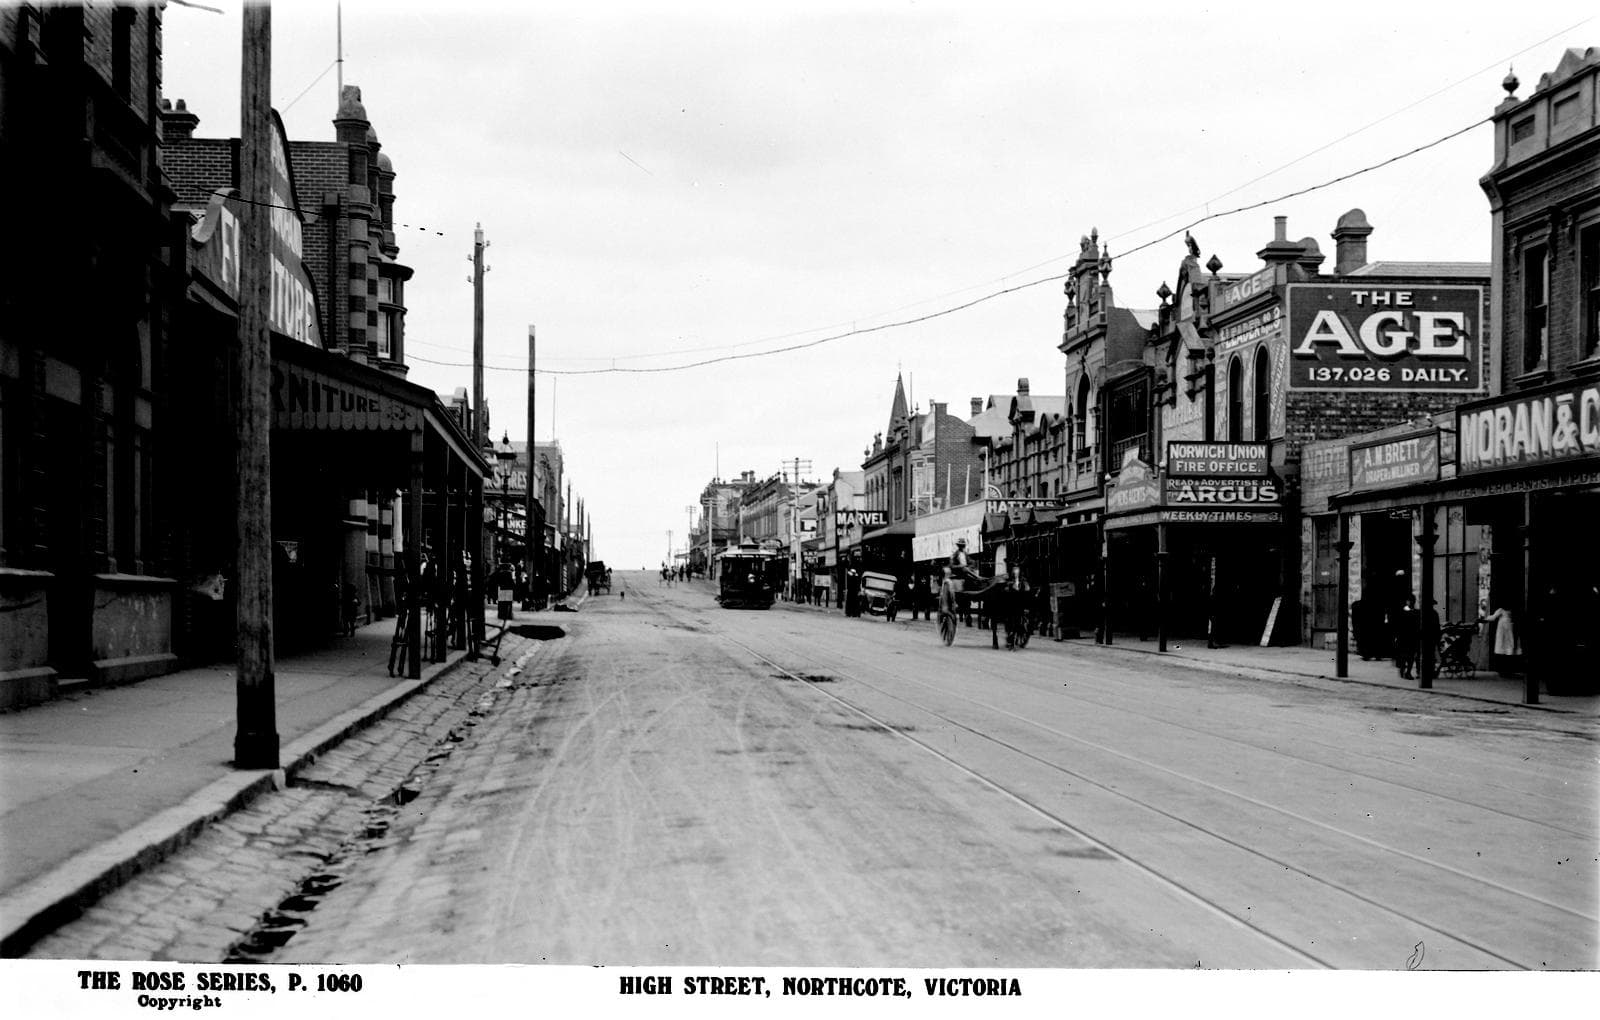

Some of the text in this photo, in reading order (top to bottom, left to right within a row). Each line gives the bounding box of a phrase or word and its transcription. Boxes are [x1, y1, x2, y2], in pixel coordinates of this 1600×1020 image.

[1351, 290, 1413, 306] THE
[1293, 309, 1466, 357] AGE
[1308, 367, 1469, 383] 137,026 DAILY.
[1460, 397, 1550, 465] MORAN
[1552, 394, 1579, 449] &
[1170, 443, 1266, 460] NORWICH UNION
[1175, 460, 1262, 473] FIRE OFFICE.
[1168, 478, 1194, 489] READ
[1176, 485, 1279, 502] ARGUS
[836, 512, 887, 525] MARVEL
